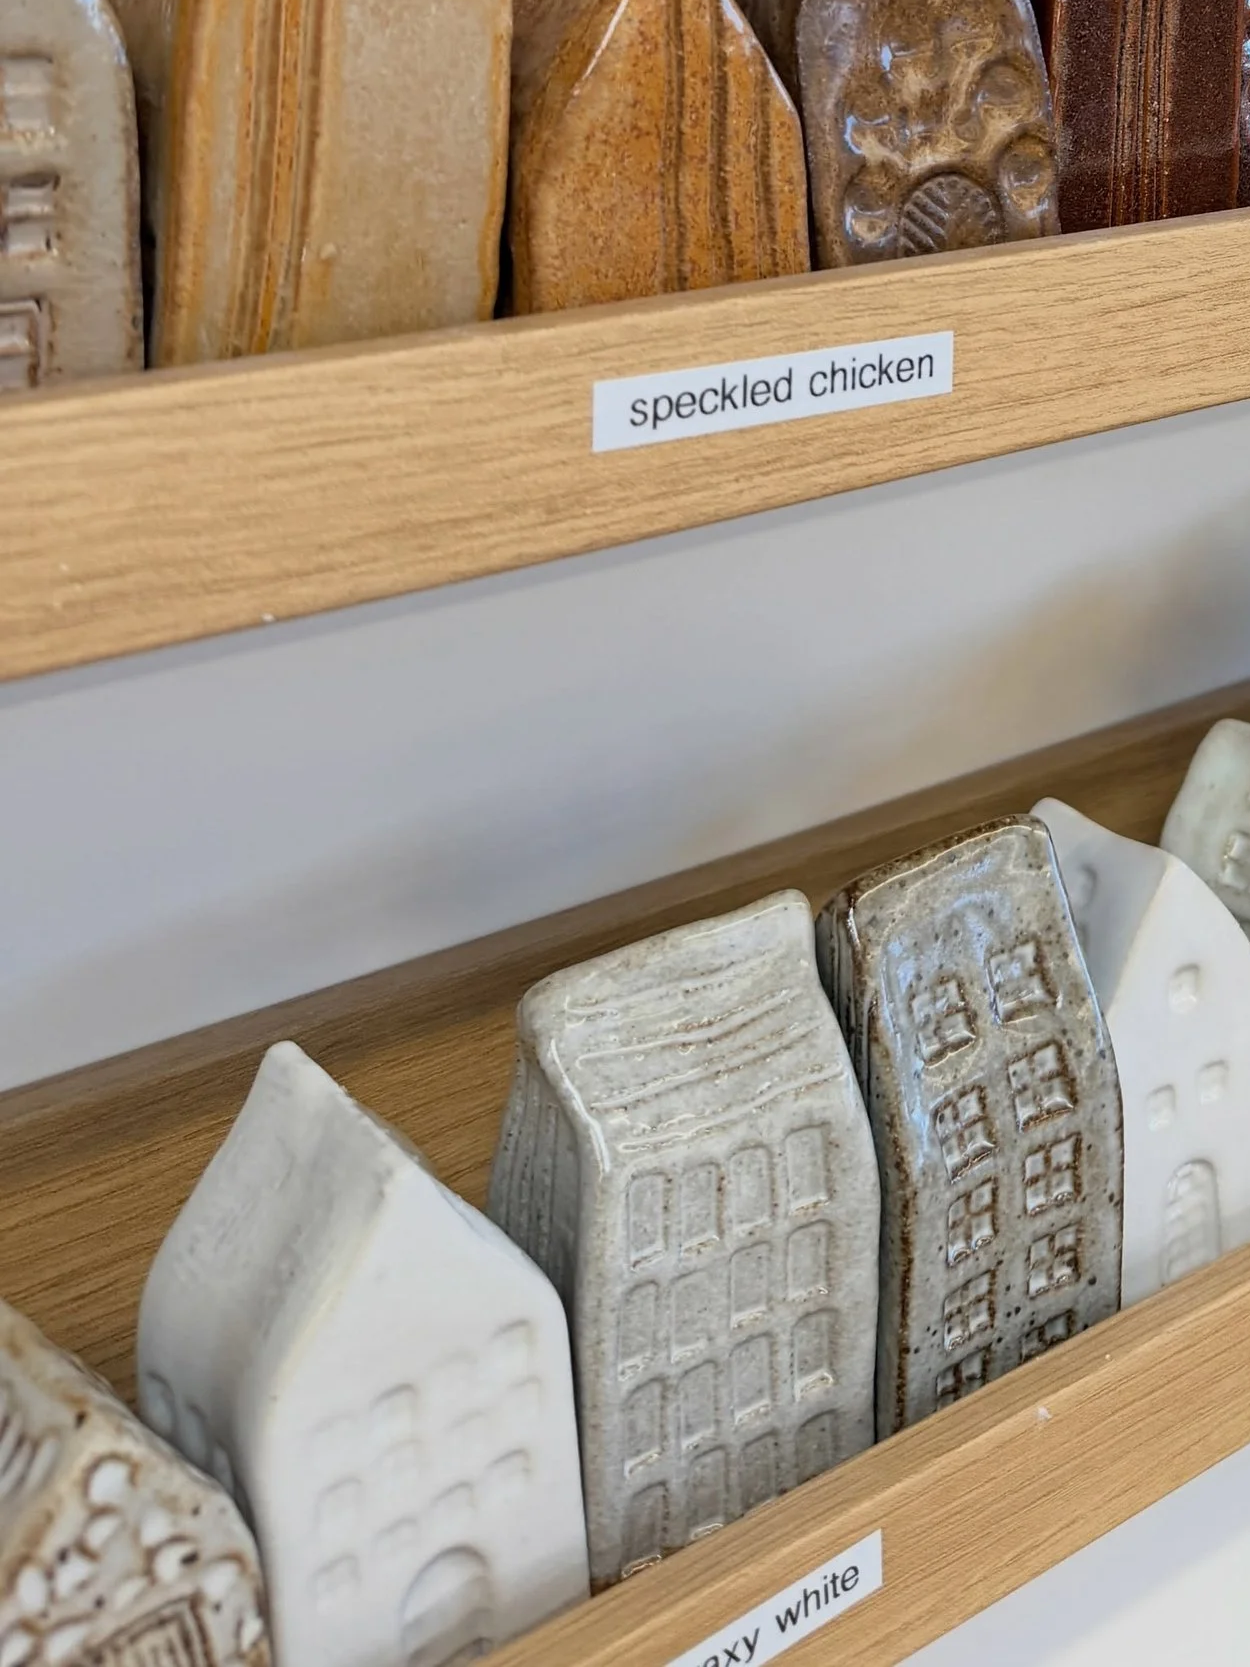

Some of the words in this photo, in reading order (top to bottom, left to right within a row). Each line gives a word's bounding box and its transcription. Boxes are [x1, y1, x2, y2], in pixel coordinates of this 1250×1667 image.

[629, 367, 793, 429] speckled
[809, 352, 935, 397] chicken
[774, 1565, 860, 1633] white
